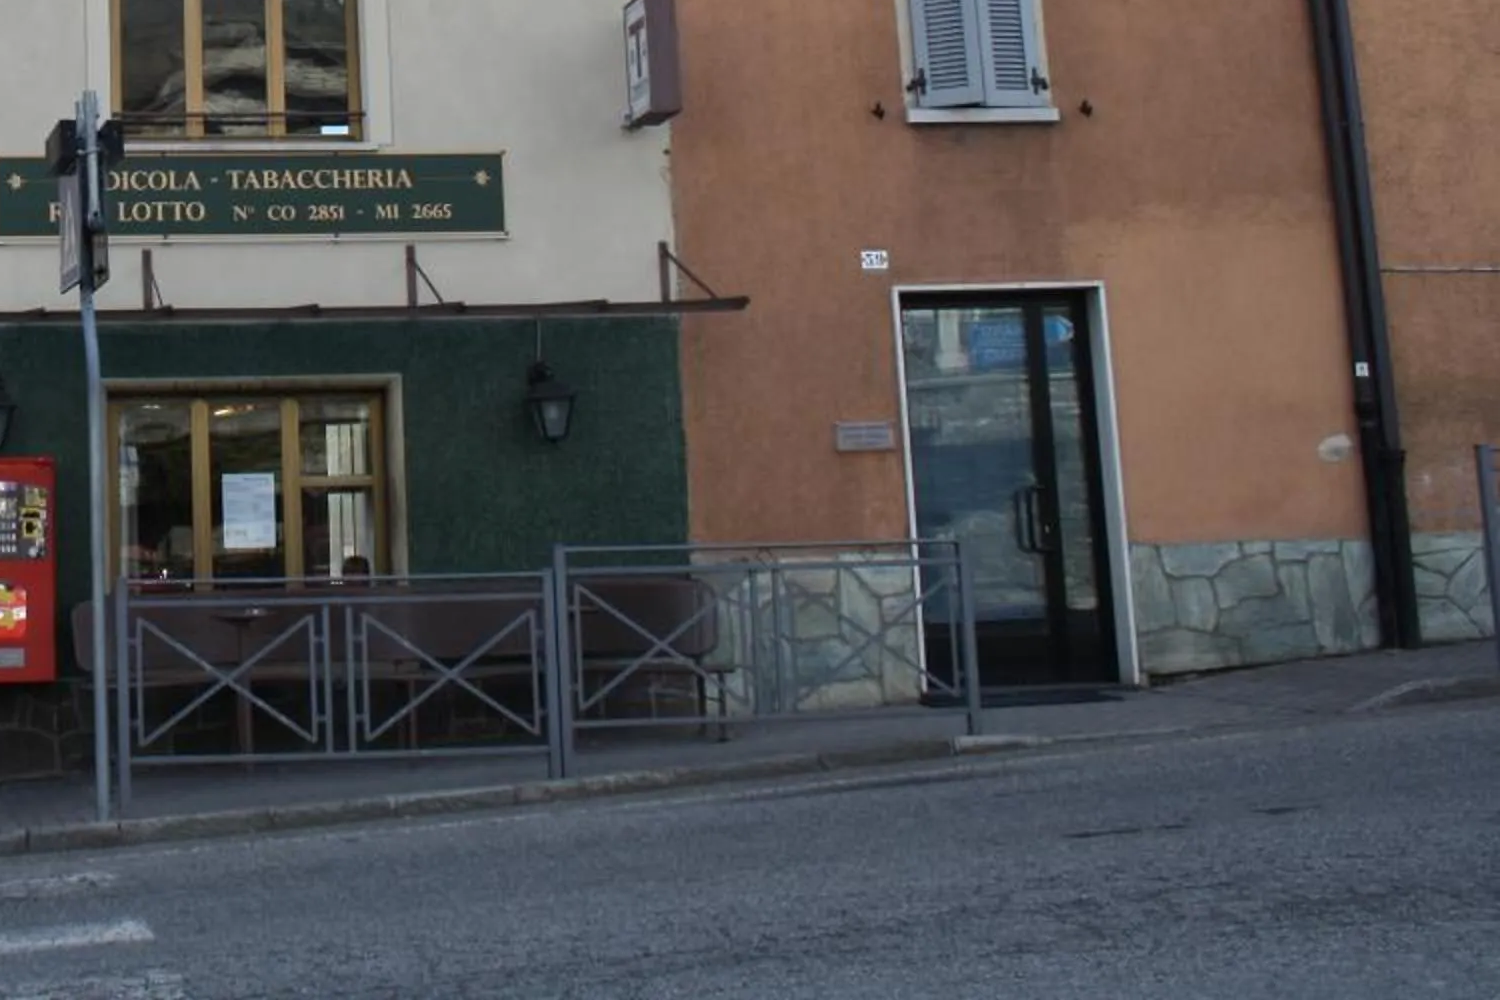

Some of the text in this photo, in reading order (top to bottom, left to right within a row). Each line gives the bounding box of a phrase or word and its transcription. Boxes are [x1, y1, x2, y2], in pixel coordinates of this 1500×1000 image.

[105, 169, 202, 191] DICOLA
[226, 168, 414, 190] TABACCHERIA
[117, 201, 206, 222] LOTTO
[266, 204, 296, 221] CO
[308, 204, 345, 221] 2851
[375, 203, 399, 220] MI
[411, 203, 452, 219] 2665
